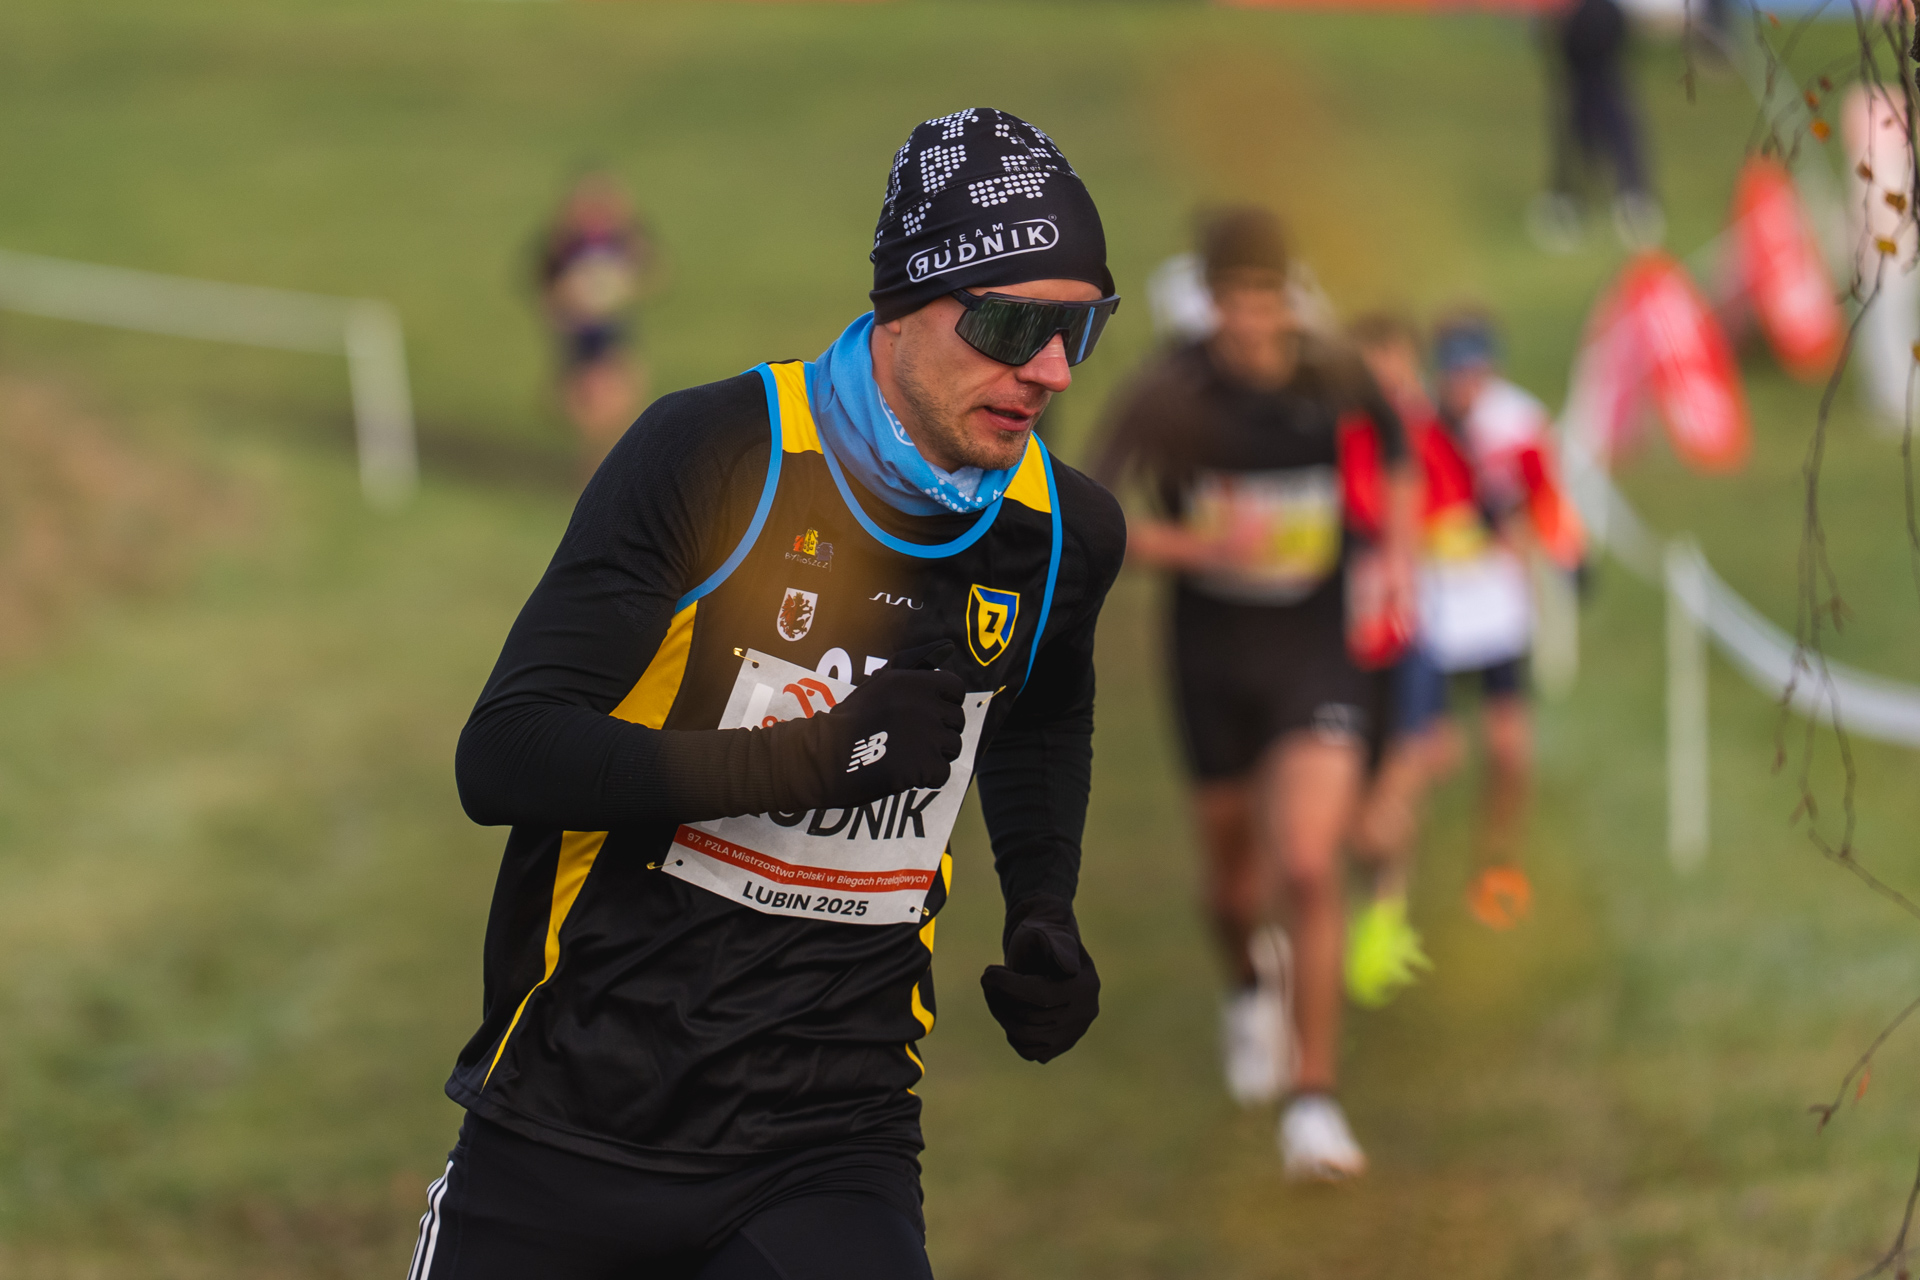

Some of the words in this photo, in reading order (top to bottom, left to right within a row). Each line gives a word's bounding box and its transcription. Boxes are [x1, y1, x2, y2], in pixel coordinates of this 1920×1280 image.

[914, 225, 1050, 278] RUDNIK
[943, 222, 1004, 247] TEAM
[687, 832, 702, 846] 97.
[704, 839, 730, 856] PZLA
[731, 849, 796, 878] Mistrzostwa
[796, 870, 826, 882] Polski
[826, 875, 835, 883] w
[836, 875, 878, 888] Biegach
[742, 880, 812, 911] LUBIN
[812, 896, 869, 917] 2025
